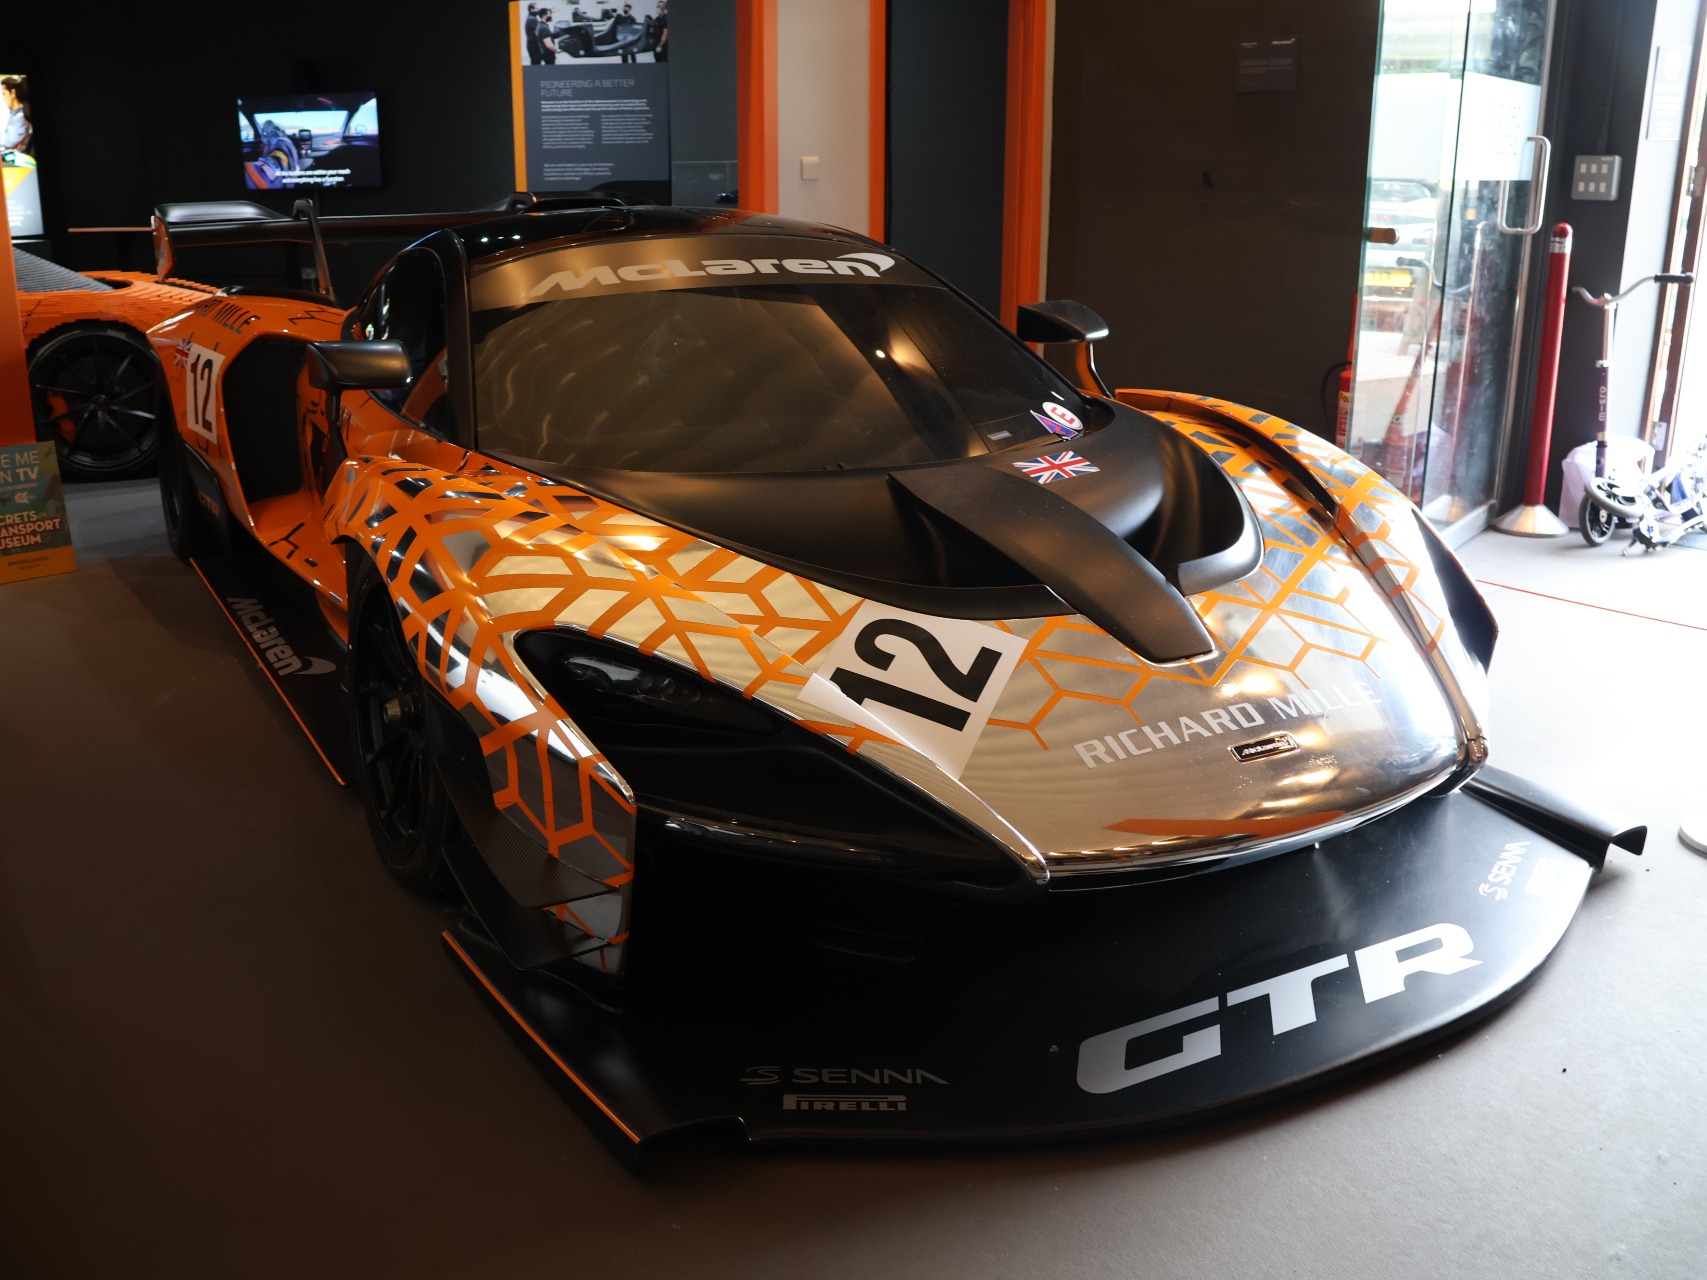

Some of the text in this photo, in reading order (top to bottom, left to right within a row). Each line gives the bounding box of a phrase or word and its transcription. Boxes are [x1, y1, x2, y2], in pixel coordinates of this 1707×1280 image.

[540, 79, 635, 89] PIONEERING A BETTER
[540, 89, 574, 97] FUTURE
[524, 253, 896, 299] McLaren
[191, 353, 214, 434] 12
[15, 451, 39, 467] ME
[15, 466, 39, 481] TV
[227, 597, 303, 676] McLaren
[829, 618, 1003, 732] 12
[1073, 681, 1383, 769] RICHARD MILLE
[1076, 922, 1484, 1094] GTR
[792, 1068, 950, 1085] SENNA
[782, 1094, 907, 1111] PIRELLI
